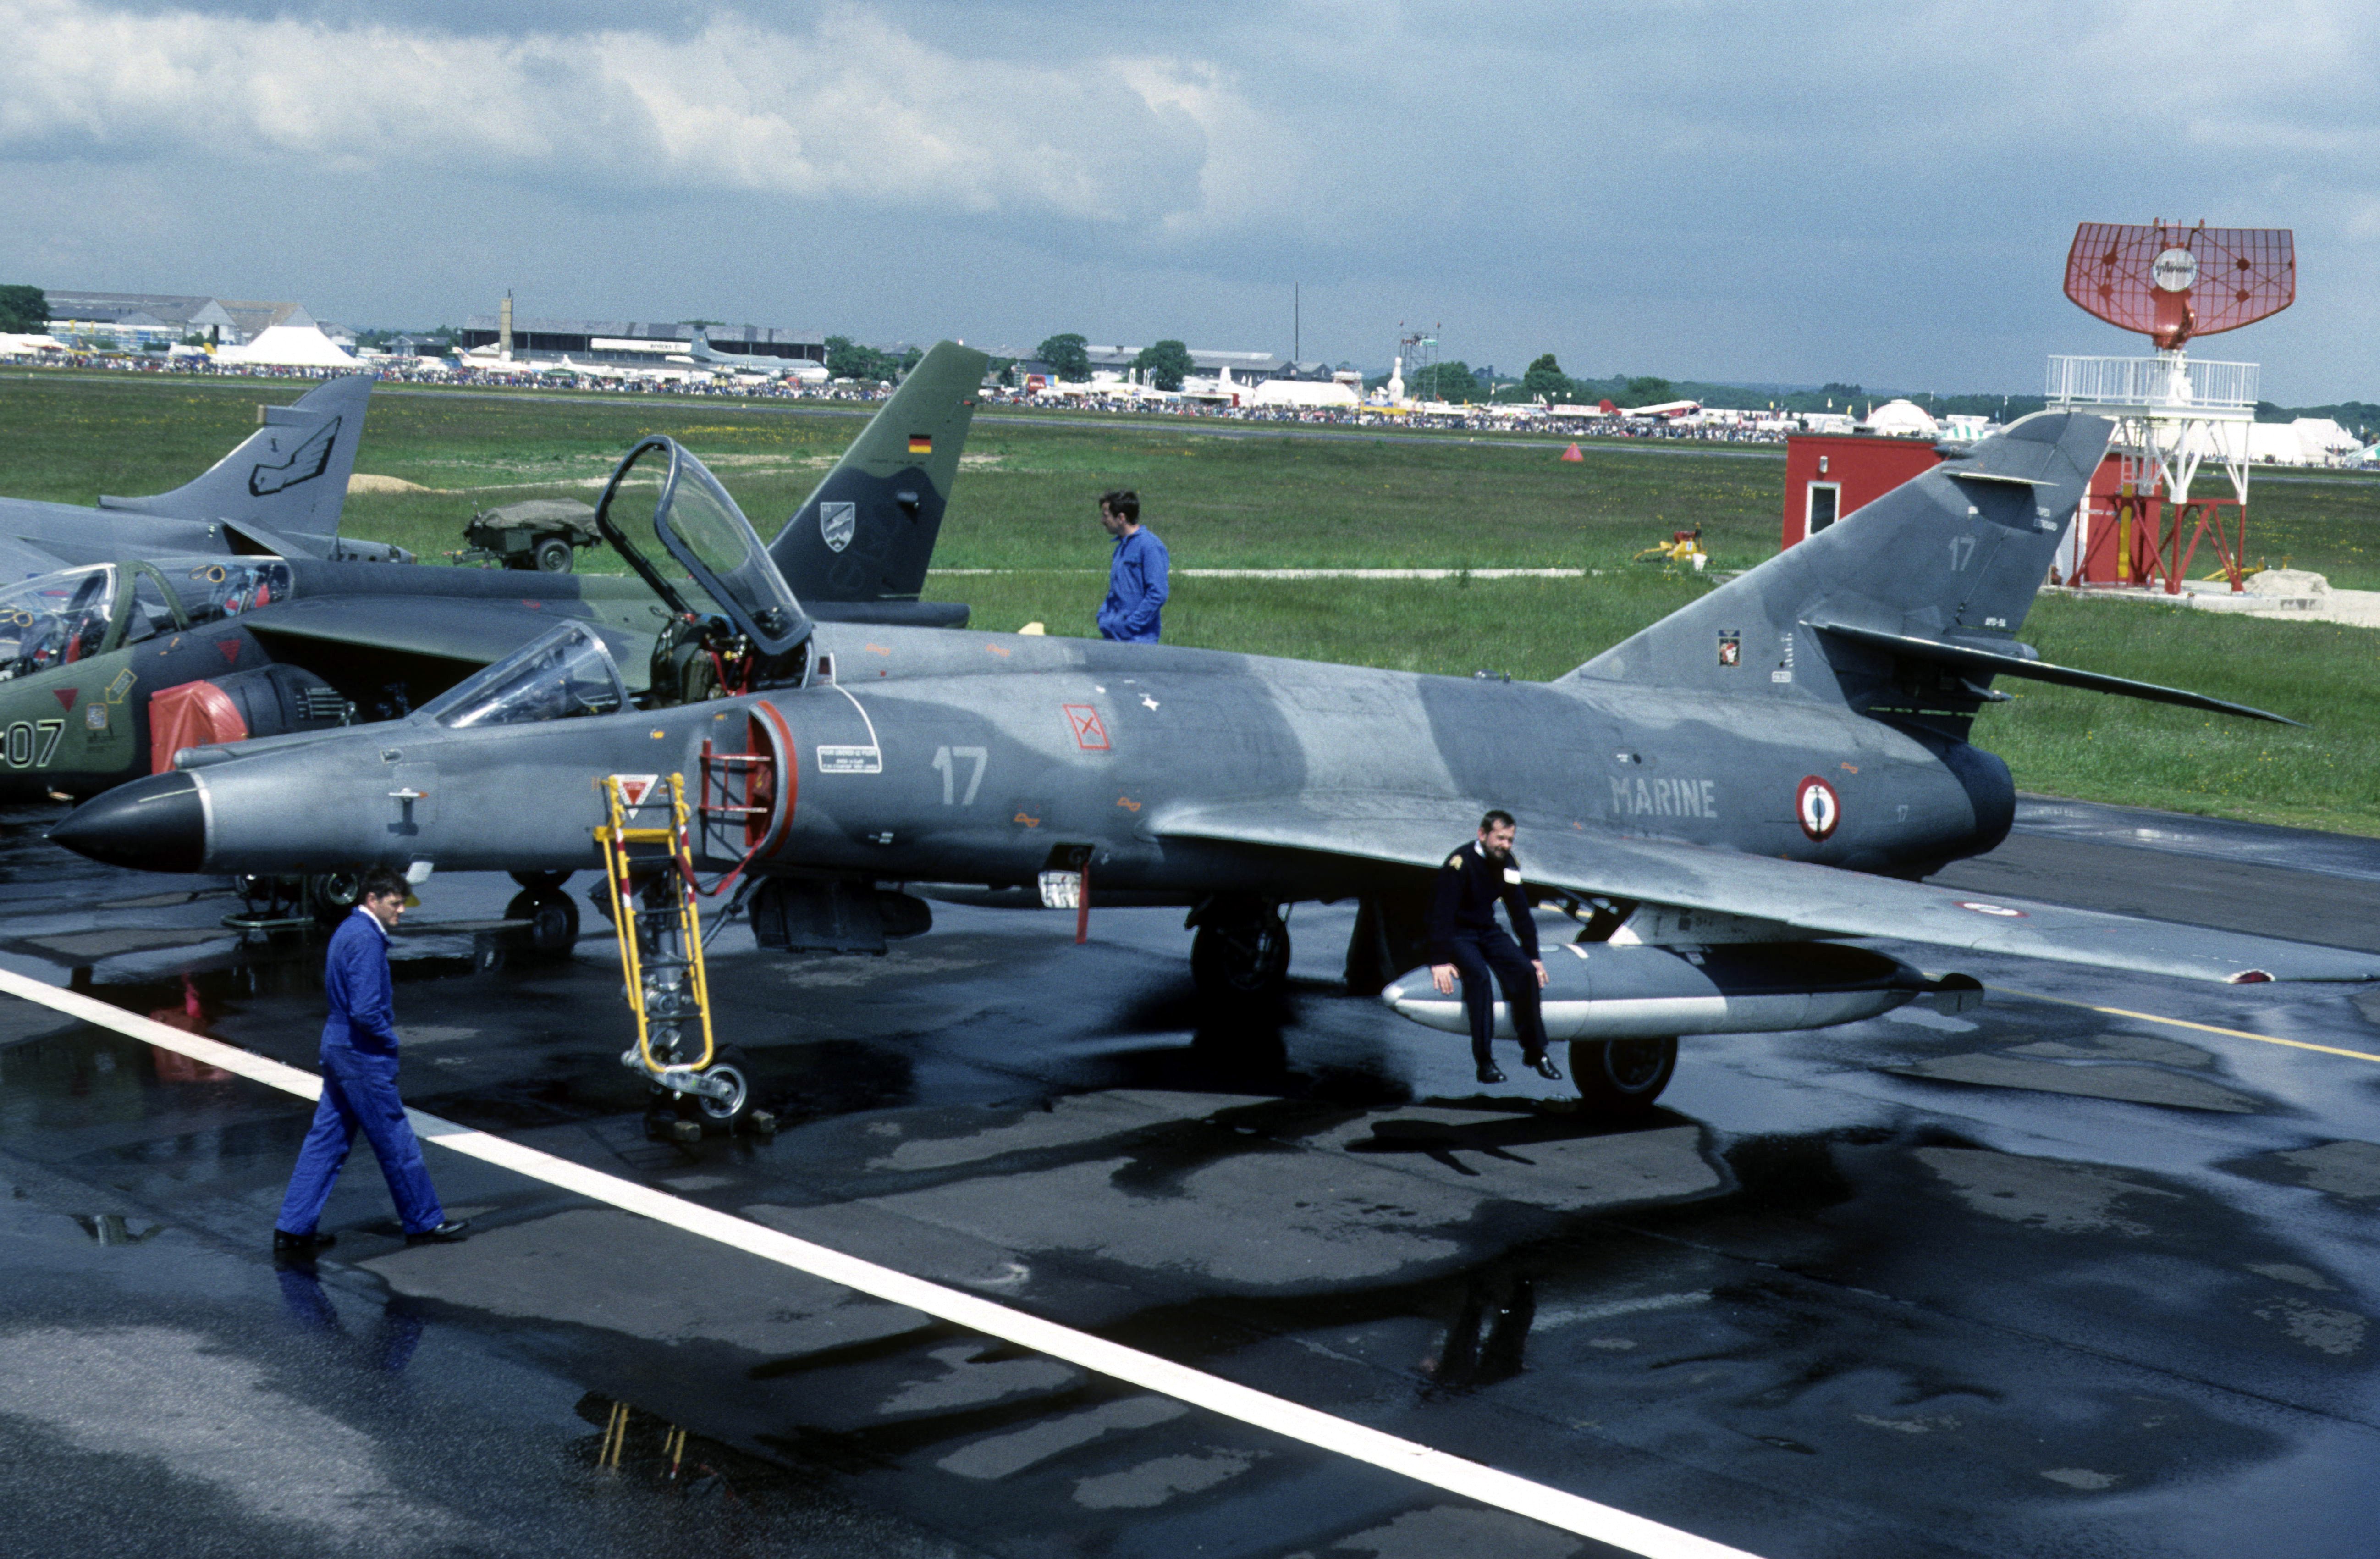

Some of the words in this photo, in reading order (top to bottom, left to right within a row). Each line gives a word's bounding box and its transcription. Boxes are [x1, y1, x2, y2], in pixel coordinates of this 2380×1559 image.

[1948, 536, 1976, 571] 17
[6, 718, 65, 769] 07
[931, 746, 988, 805] 17
[1609, 776, 1717, 818] MARINE
